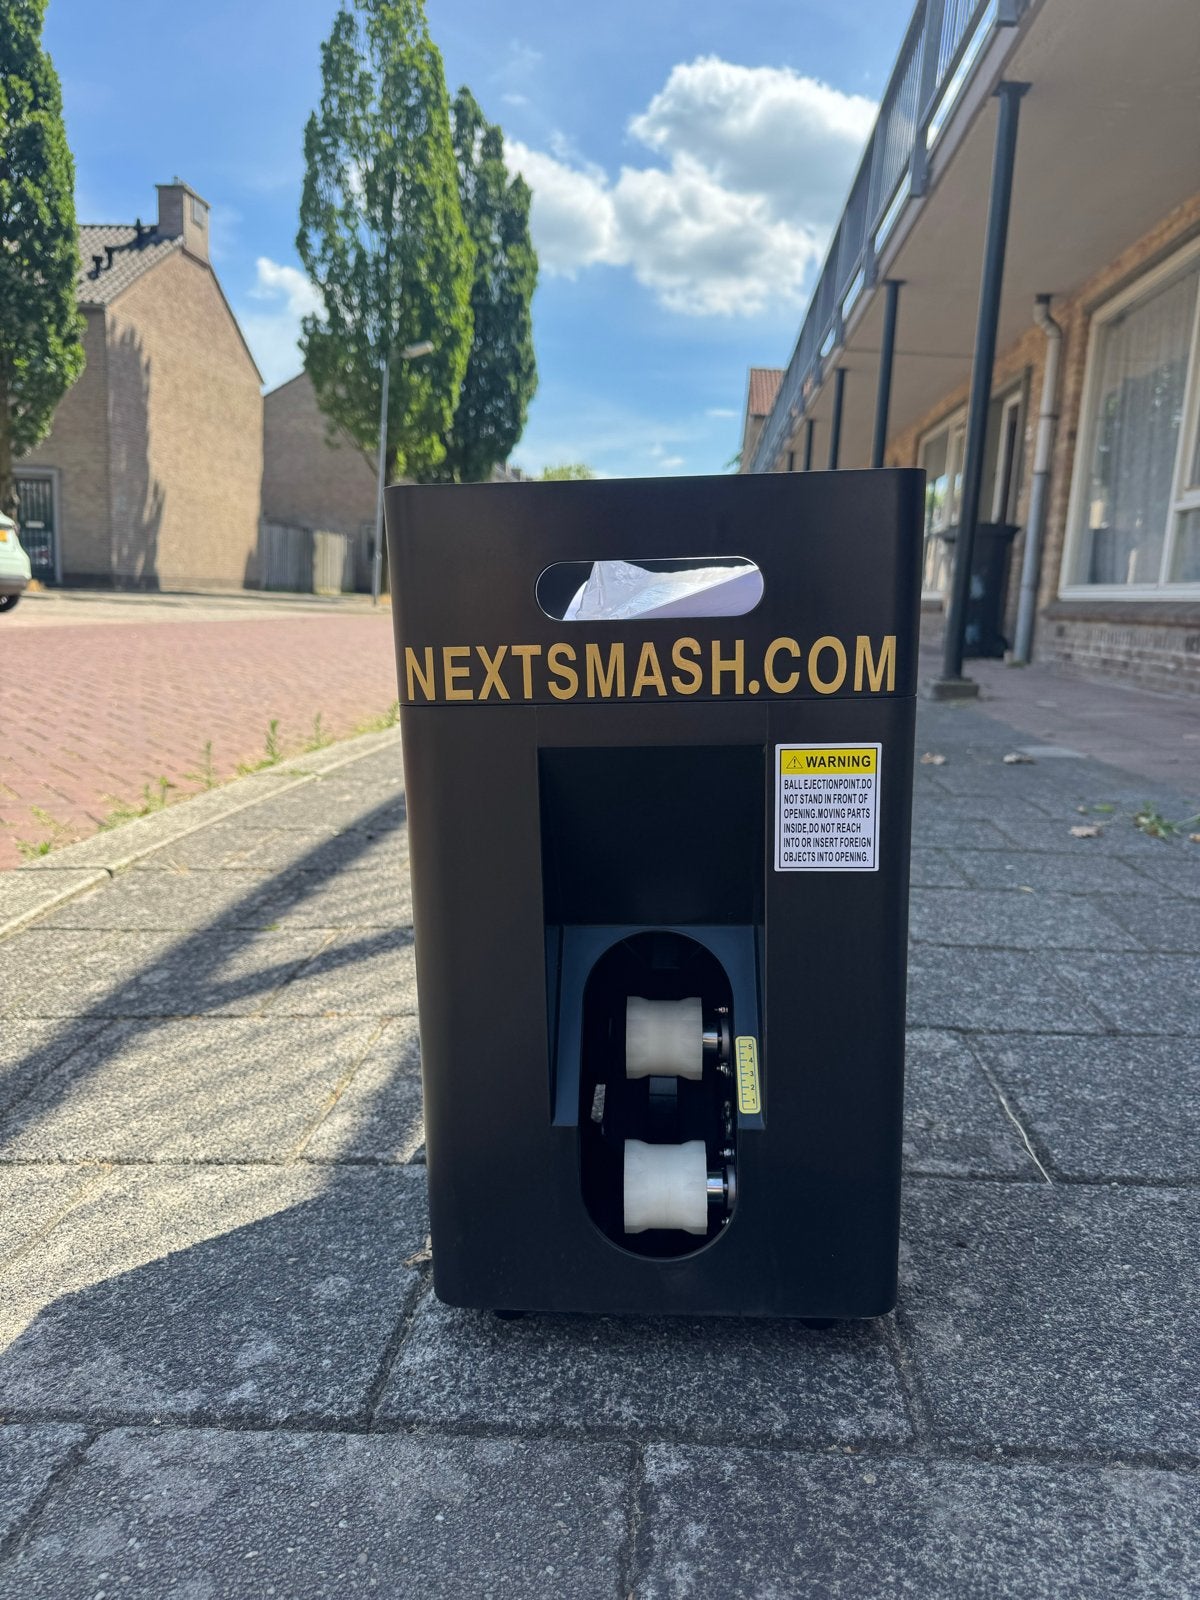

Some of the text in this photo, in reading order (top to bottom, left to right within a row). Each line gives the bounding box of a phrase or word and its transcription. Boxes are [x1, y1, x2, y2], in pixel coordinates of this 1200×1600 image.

[404, 635, 896, 701] NEXTSMASH.COM
[806, 755, 871, 768] WARNING
[784, 779, 802, 789] BALL
[784, 794, 868, 804] NOT STAND IN FRONT OF
[847, 808, 870, 818] PARTS
[821, 823, 835, 833] NOT
[836, 823, 861, 833] REACH
[784, 837, 871, 847] INTO OR INSERT FOREIGN
[784, 852, 868, 861] OBJECTS INTO OPENING.
